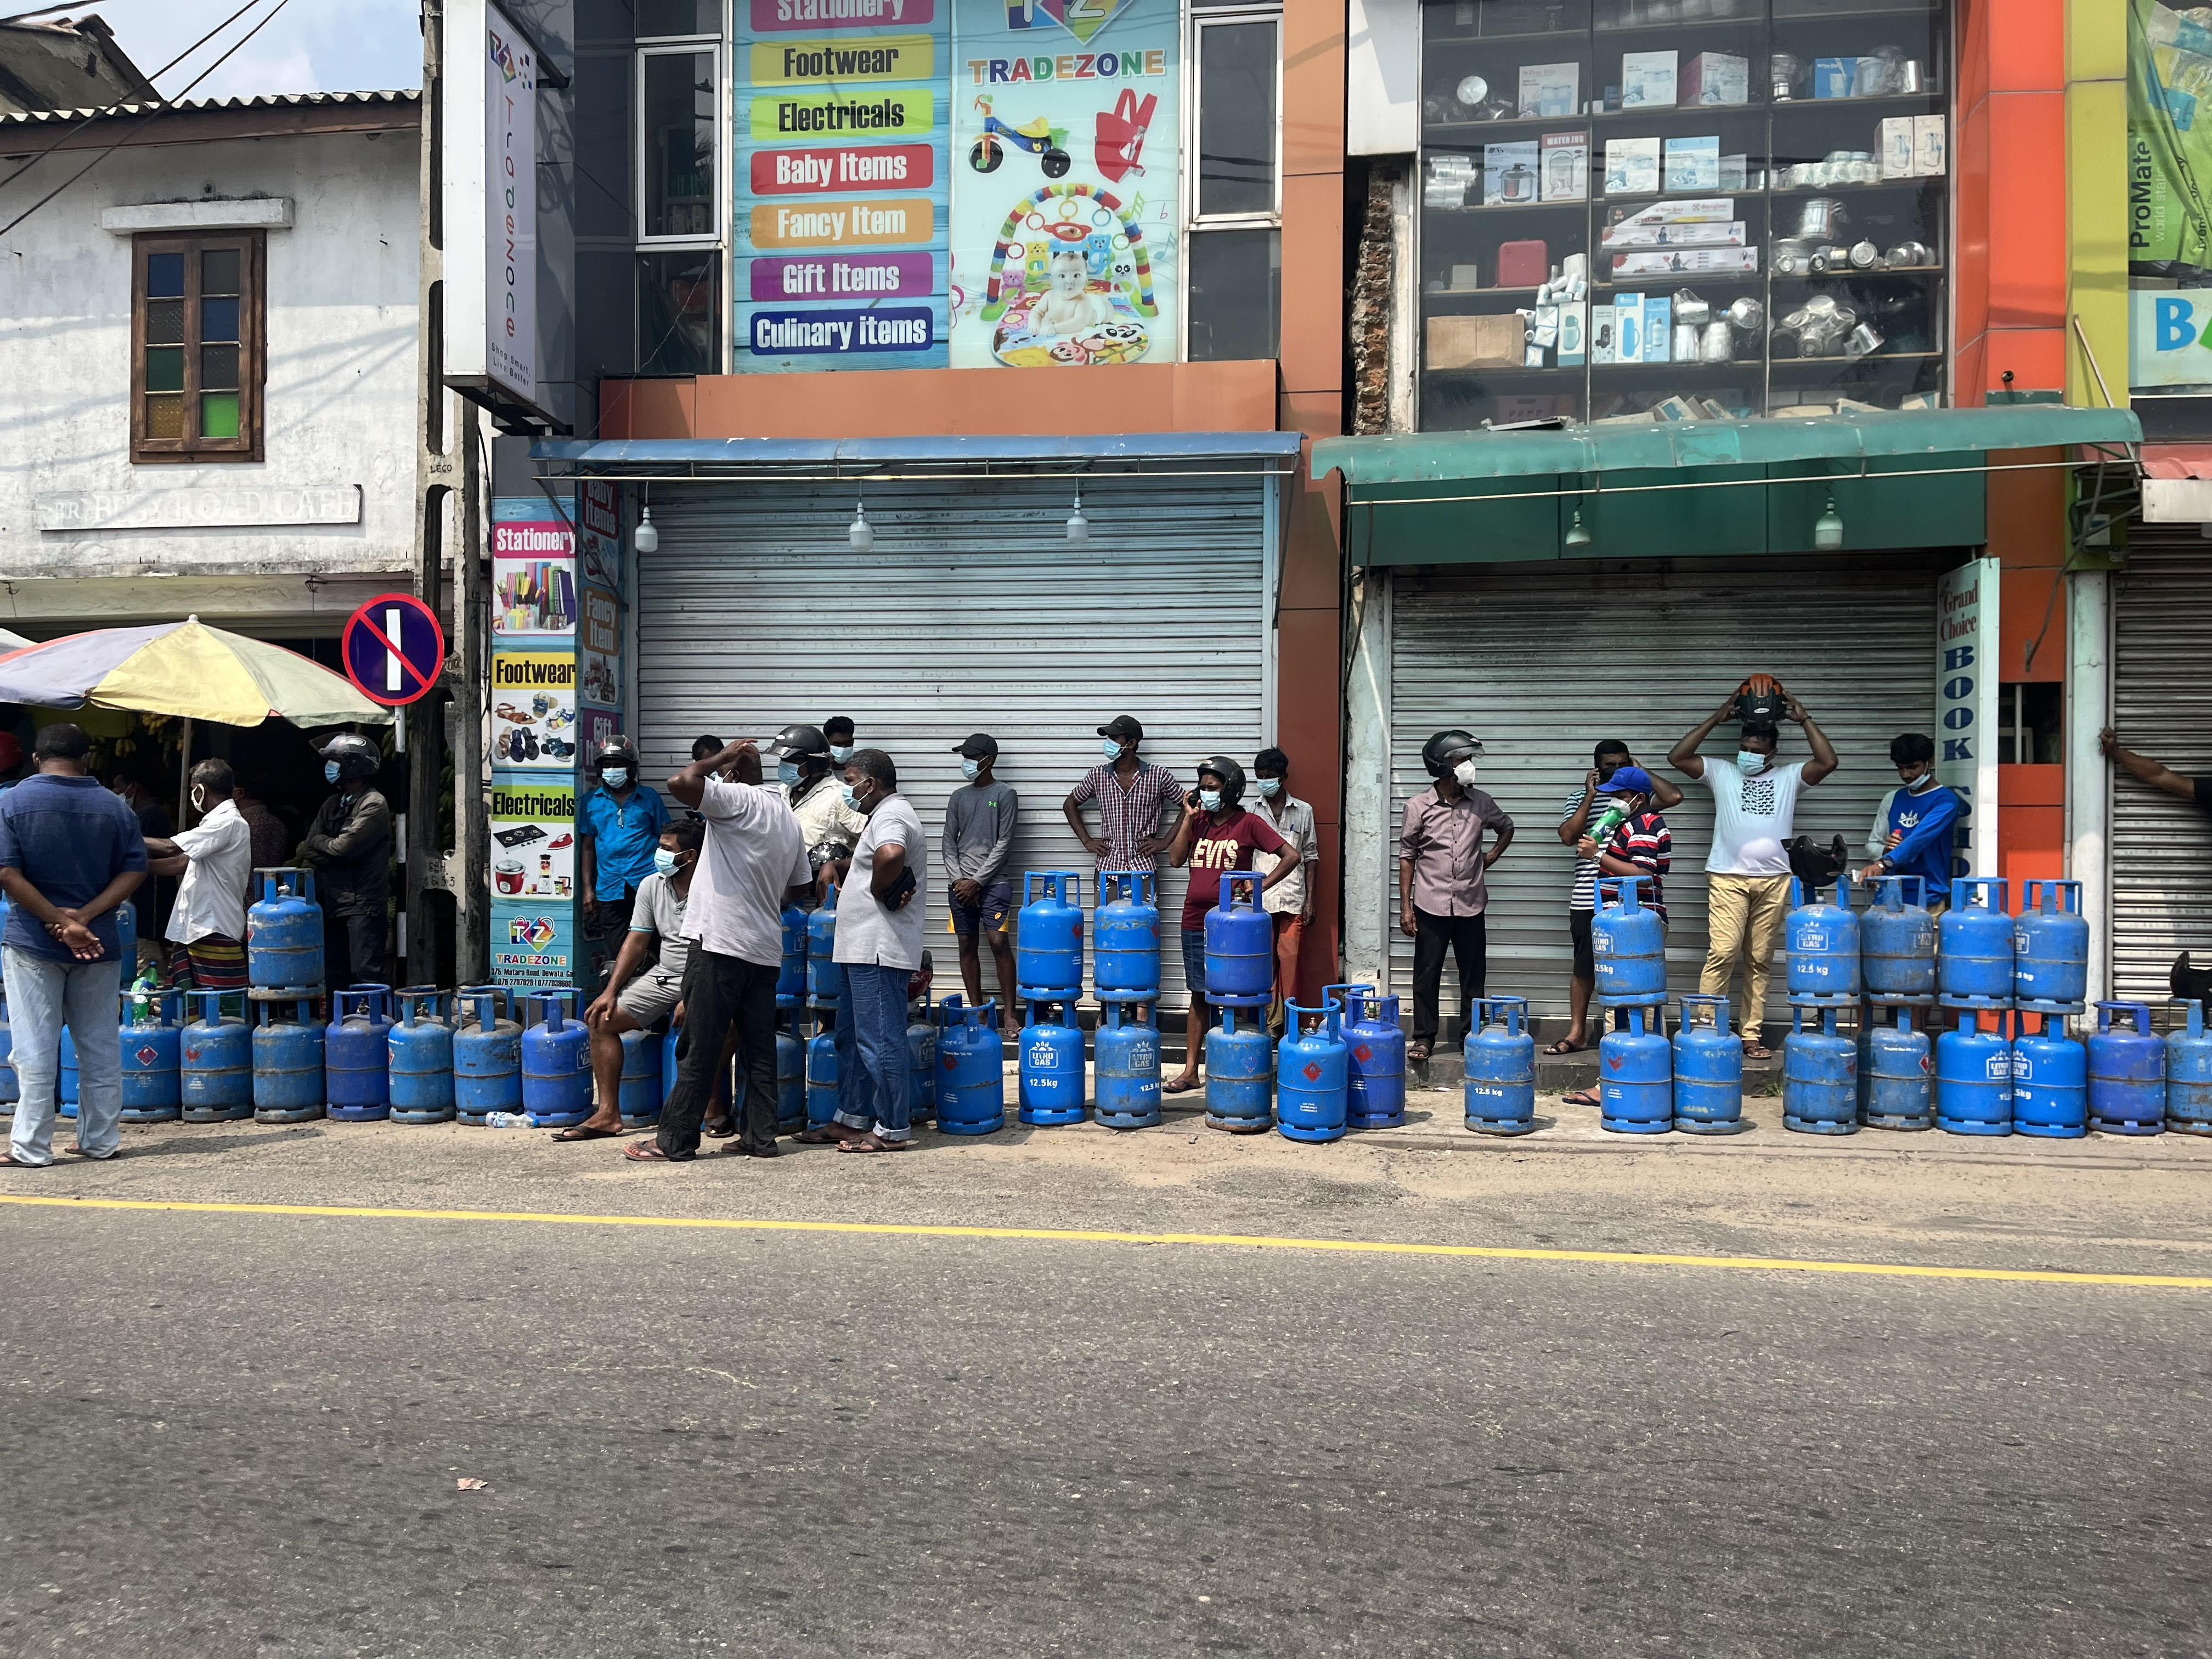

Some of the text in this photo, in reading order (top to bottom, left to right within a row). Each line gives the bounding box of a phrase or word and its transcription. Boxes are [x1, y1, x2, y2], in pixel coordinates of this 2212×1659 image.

[777, 0, 905, 21] Stationery
[784, 47, 899, 77] Footwear
[967, 49, 1165, 84] TRADEZONE
[778, 99, 905, 132] Electricals
[1547, 136, 1584, 145] WATER JUG
[776, 153, 907, 187] Baby Items
[2130, 141, 2152, 248] ProMate
[777, 206, 906, 240] Fancy Item
[783, 263, 900, 294] Gift Items
[757, 315, 927, 350] Culinary items
[492, 342, 530, 377] Shop Smart,
[493, 357, 529, 386] Live Better
[585, 497, 616, 535] Items
[496, 528, 575, 554] Stationery
[586, 590, 616, 628] Fancy
[1944, 579, 1978, 614] Grand
[590, 619, 613, 651] Item
[1940, 612, 1977, 641] Choice
[496, 659, 575, 684] Footwear
[1943, 645, 1974, 761] BOOK
[493, 792, 575, 816] Electricals
[496, 953, 567, 966] TRADEZONE
[1594, 964, 1613, 975] 2.5kg
[1797, 964, 1829, 976] 12.5 kg
[1030, 1079, 1058, 1088] 12.5kg
[1140, 1083, 1154, 1092] 12.5
[1492, 1088, 1503, 1097] kg
